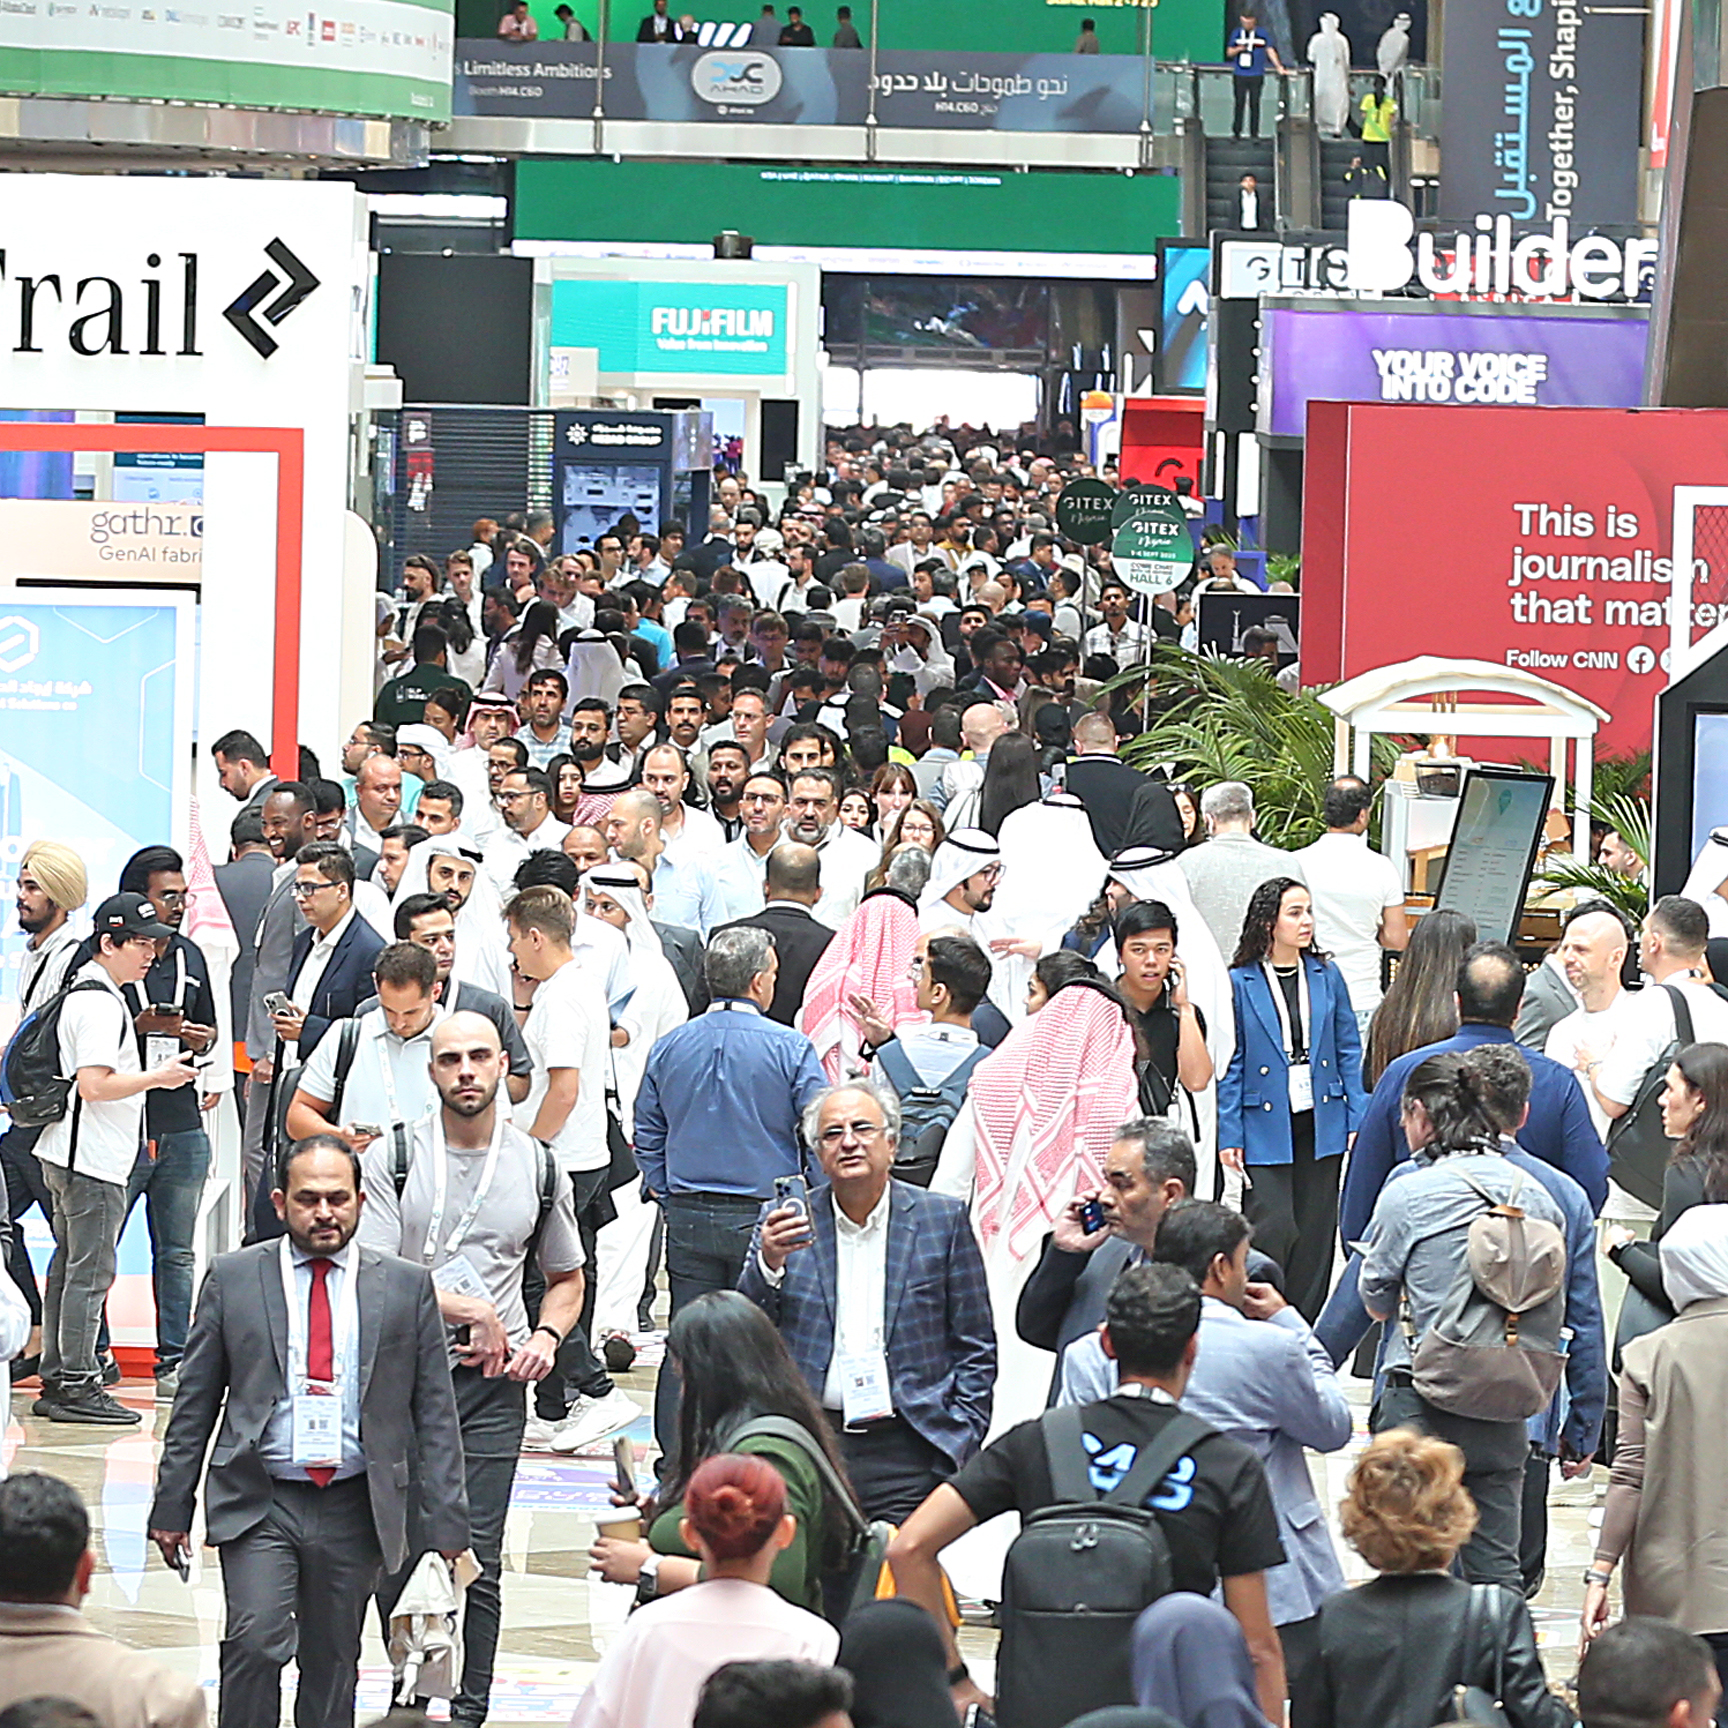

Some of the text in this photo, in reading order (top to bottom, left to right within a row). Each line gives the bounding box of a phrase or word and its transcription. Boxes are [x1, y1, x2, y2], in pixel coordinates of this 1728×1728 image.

[464, 61, 529, 77] Limitless
[533, 62, 612, 79] Ambitions
[868, 71, 1068, 100] نحو طموحات بلا حدود
[1546, 85, 1580, 221] Together,
[1347, 198, 1659, 297] Builder
[651, 307, 775, 337] FUJIFILM
[1372, 349, 1548, 381] YOUR VOICE
[1381, 374, 1538, 403] INTO CODE
[1063, 497, 1114, 510] GITEX
[1128, 494, 1172, 506] GITEX
[1131, 521, 1179, 536] GITEX
[1513, 503, 1639, 538] This is
[99, 545, 156, 562] GenAI
[1507, 546, 1710, 587] journalism
[1130, 574, 1174, 586] HALL 6
[1510, 590, 1593, 624] that
[1506, 650, 1619, 669] Follow CNN
